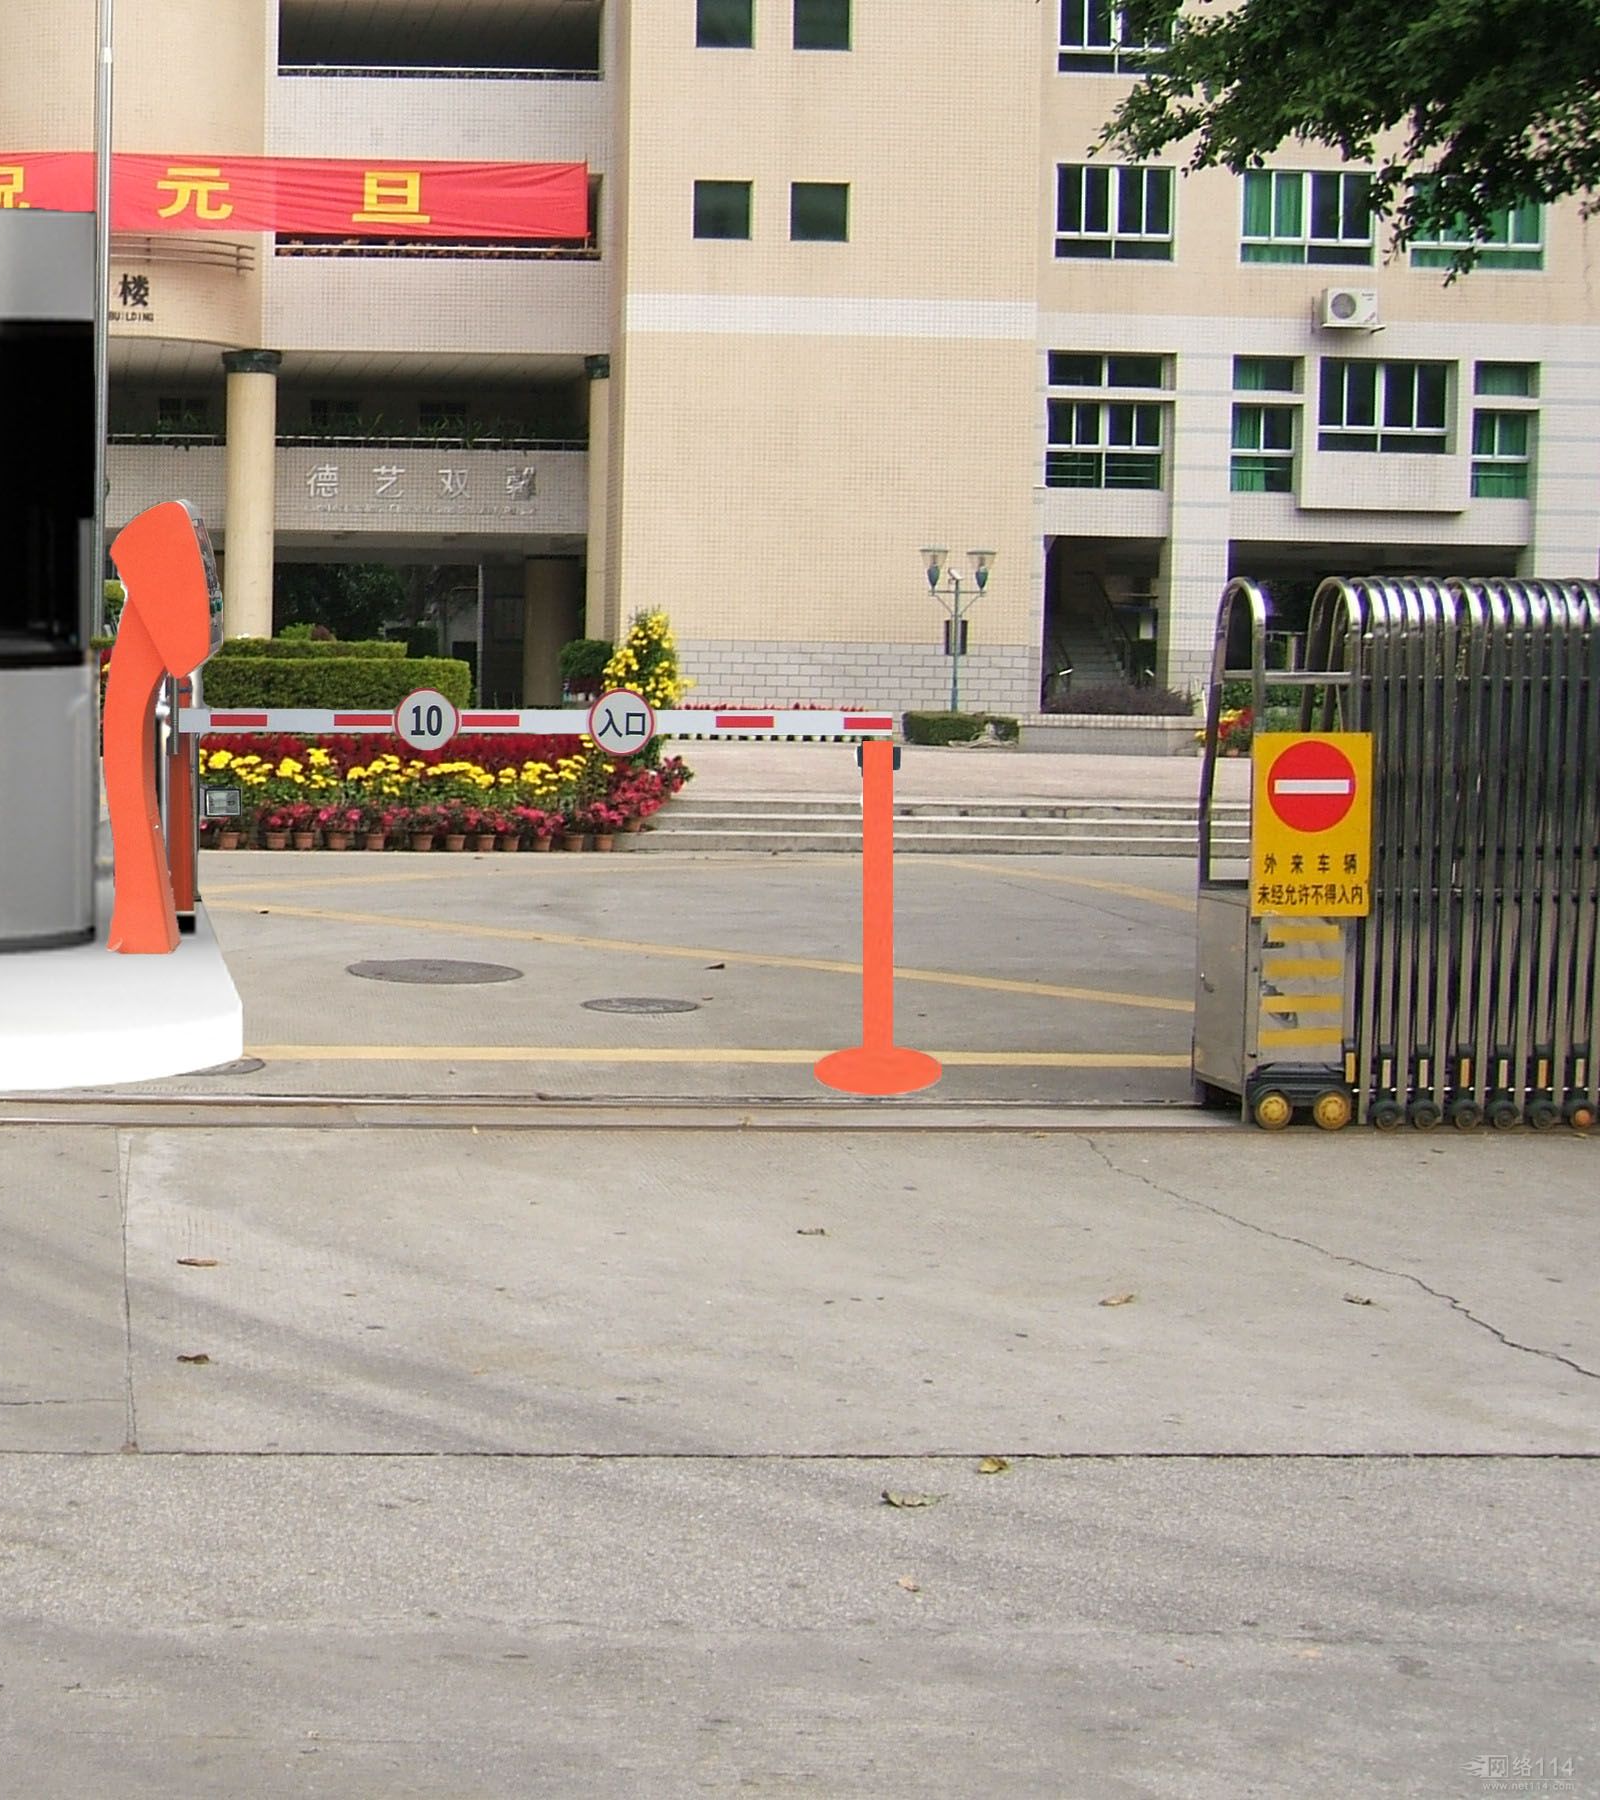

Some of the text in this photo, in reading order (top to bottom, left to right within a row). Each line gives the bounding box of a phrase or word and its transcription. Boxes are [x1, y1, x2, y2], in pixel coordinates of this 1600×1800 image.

[118, 273, 149, 306] 楼
[410, 705, 443, 737] 10
[598, 708, 646, 738] 入口
[1264, 853, 1357, 874] 外来车辆
[1258, 884, 1363, 905] 未经允许不得入内
